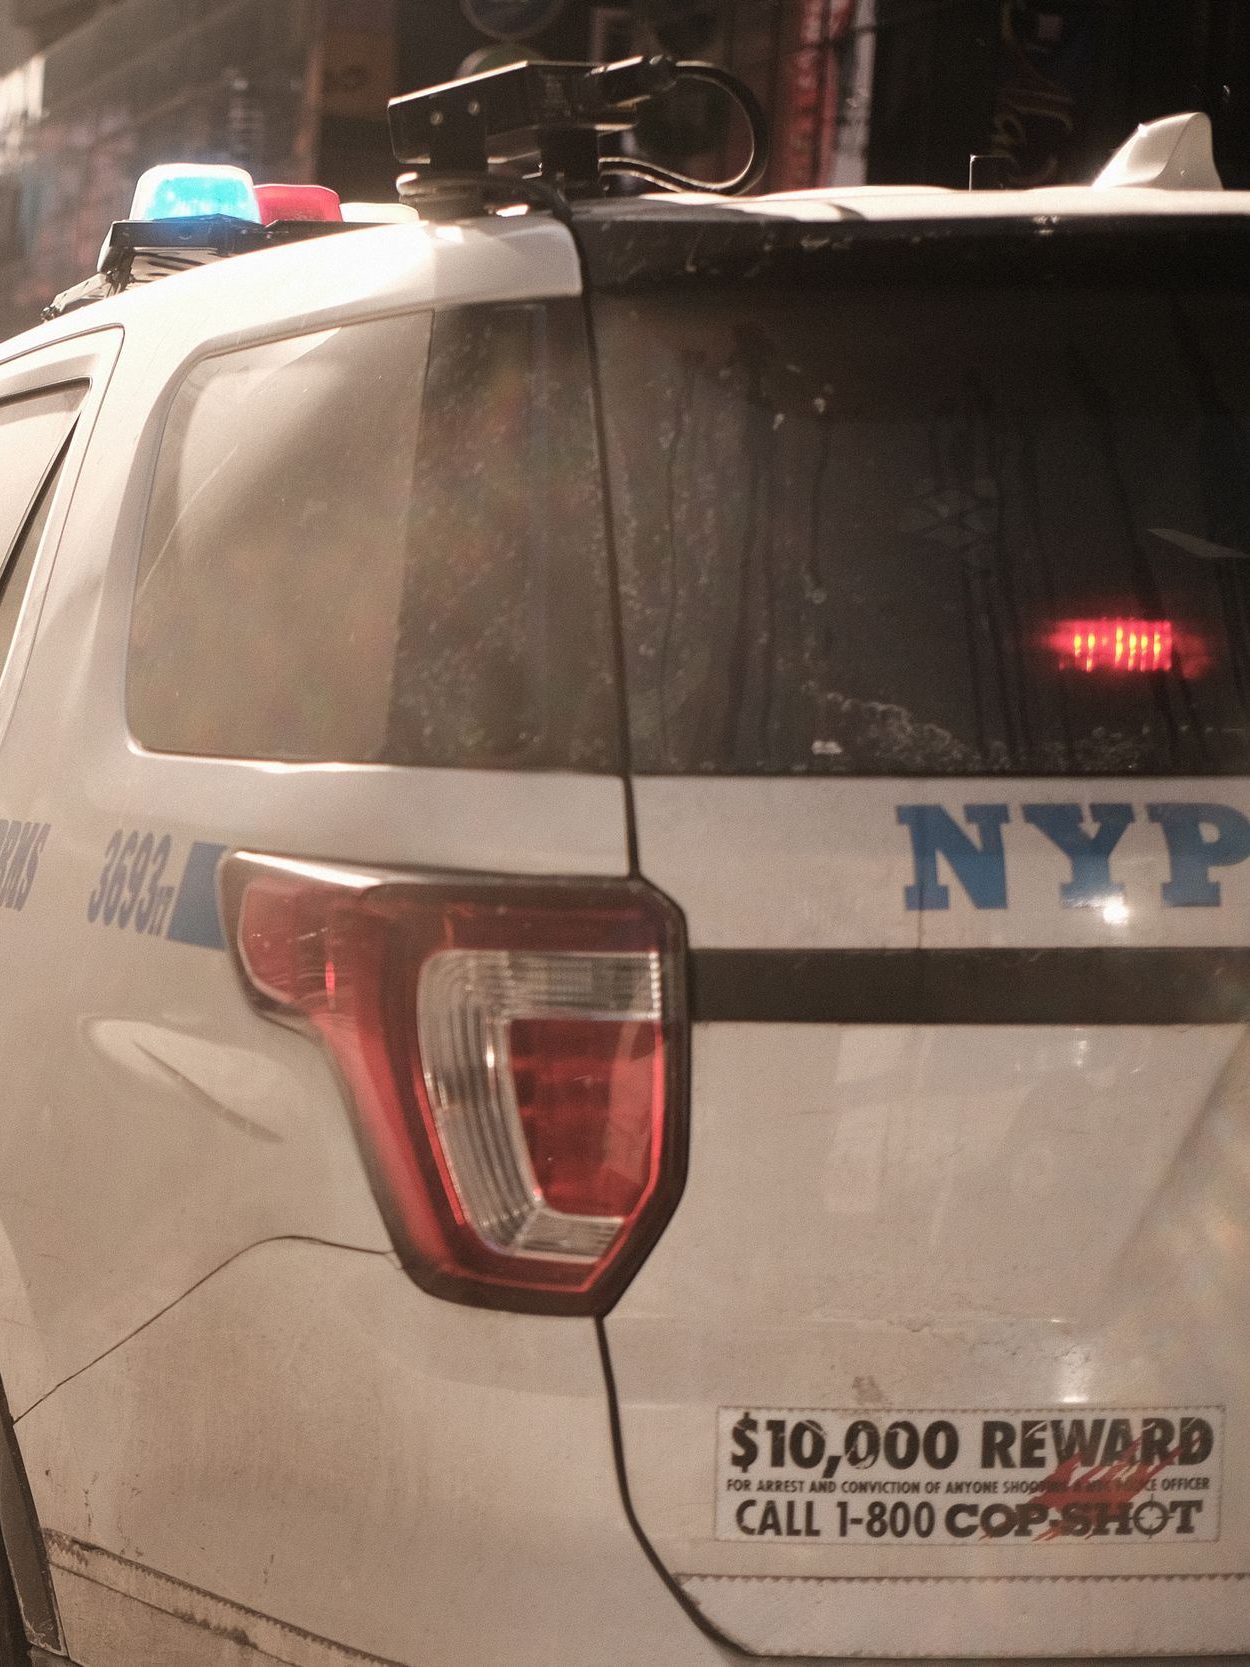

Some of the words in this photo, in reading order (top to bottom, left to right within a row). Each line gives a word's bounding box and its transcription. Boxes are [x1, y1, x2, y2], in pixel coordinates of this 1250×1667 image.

[730, 1411, 960, 1479] $10,000
[981, 1417, 1214, 1468] REWARD
[726, 1478, 752, 1493] FOR
[756, 1480, 804, 1494] ARREST
[809, 1480, 837, 1494] AND
[841, 1481, 921, 1495] CONVICTION
[925, 1481, 941, 1495] OF
[945, 1481, 998, 1495] ANYONE
[1161, 1477, 1210, 1491] OFFICER
[735, 1499, 821, 1537] CALL
[836, 1500, 936, 1538] 1-800
